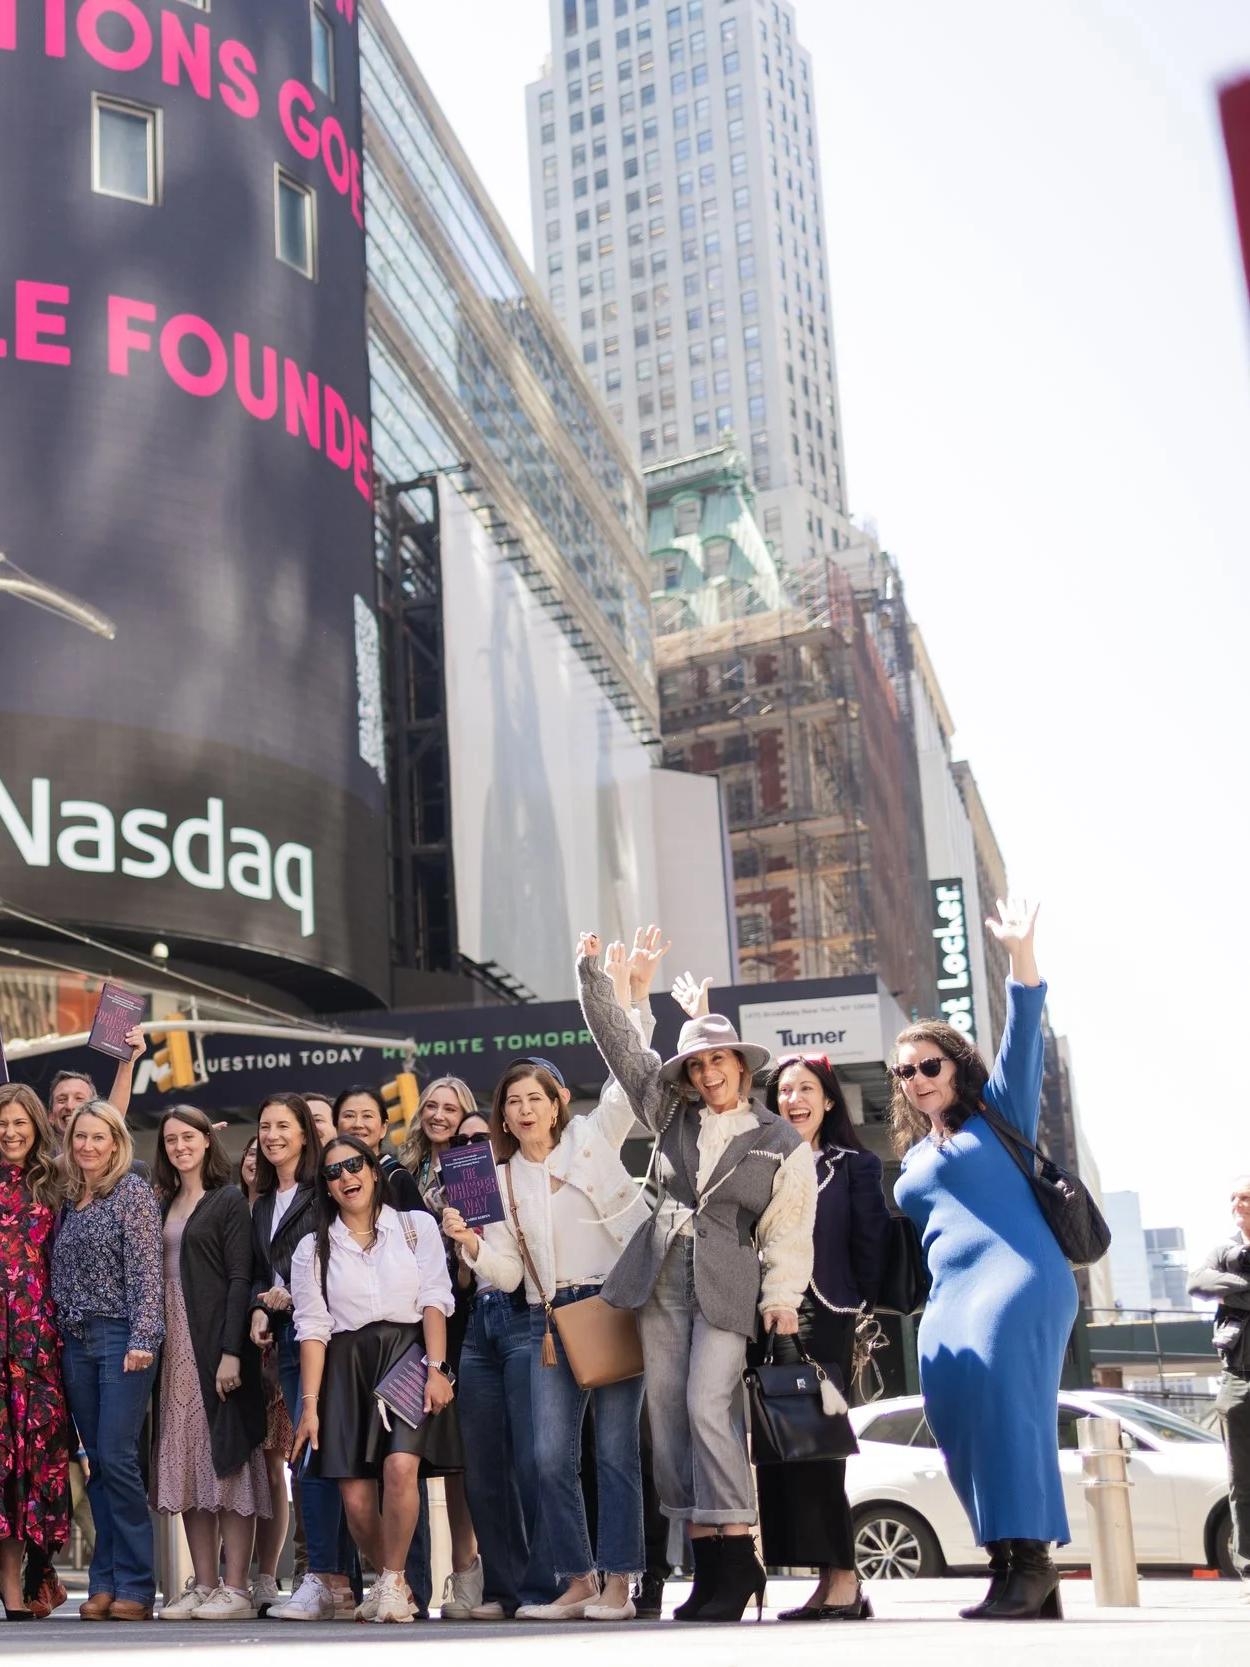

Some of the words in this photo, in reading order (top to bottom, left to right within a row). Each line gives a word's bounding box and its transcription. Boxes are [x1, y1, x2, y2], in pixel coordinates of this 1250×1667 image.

[107, 294, 372, 503] FOUNDE
[932, 885, 969, 990] Locker
[775, 1029, 847, 1047] Turner
[193, 1051, 291, 1074] QUESTION
[299, 1046, 365, 1066] TODAY
[461, 1166, 478, 1181] THE
[446, 1176, 498, 1202] WHISPER
[463, 1195, 488, 1217] WAY
